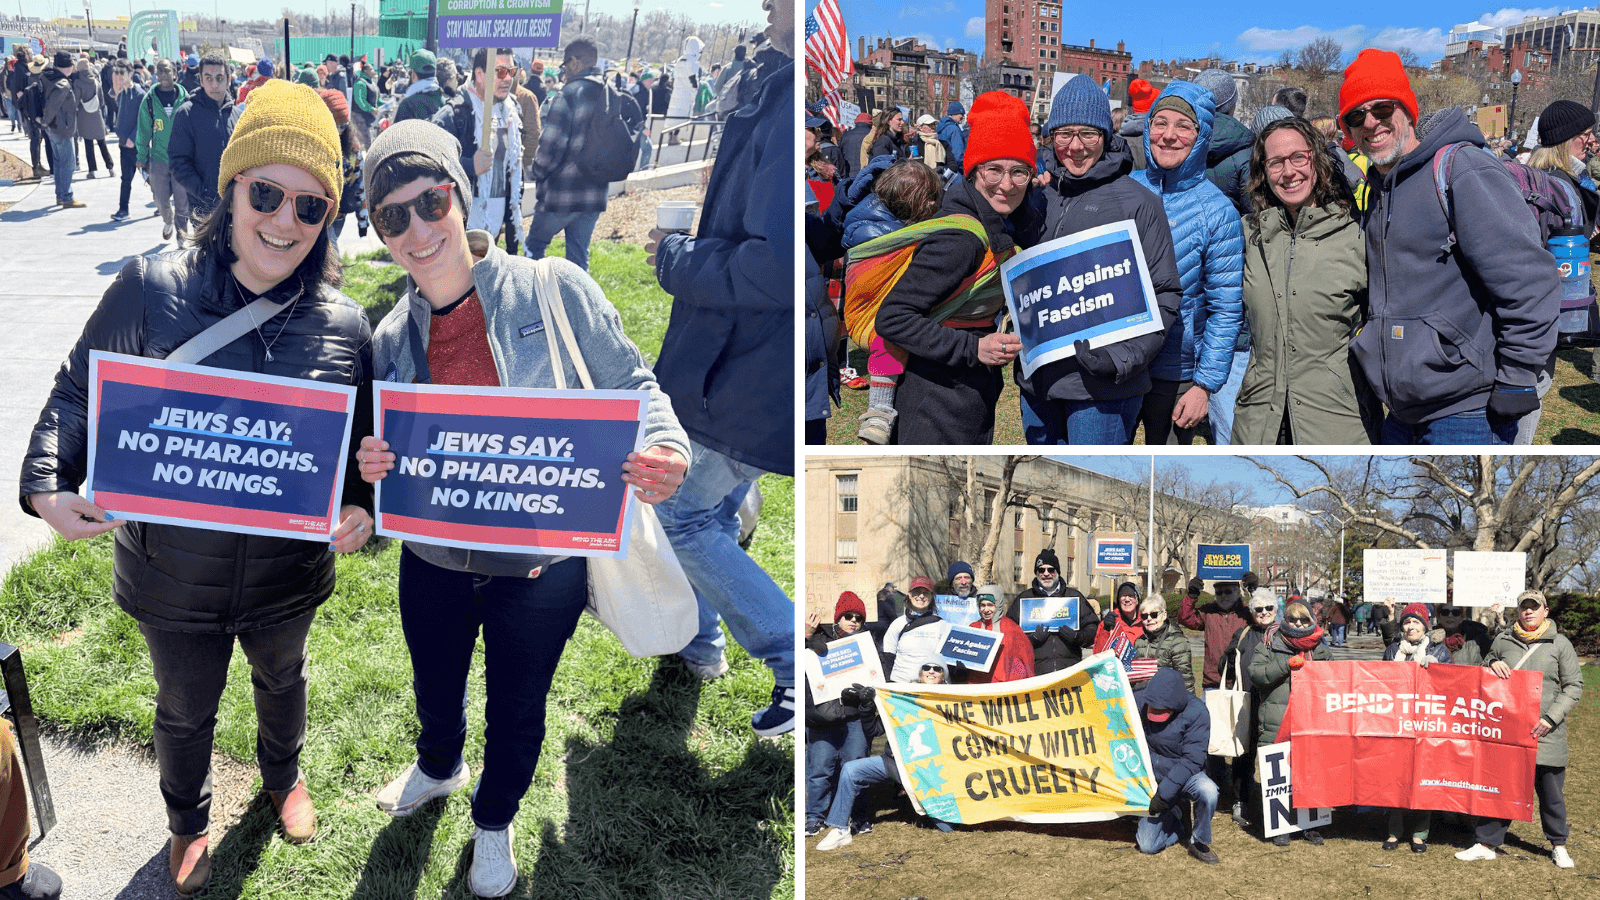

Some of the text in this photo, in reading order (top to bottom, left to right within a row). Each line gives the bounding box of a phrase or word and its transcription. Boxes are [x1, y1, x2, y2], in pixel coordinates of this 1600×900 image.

[448, 0, 550, 10] CORRUPTION & CRONYISM
[447, 18, 552, 38] STAY VIGILANT. SPEAK OUT. RESIST.
[1019, 258, 1131, 312] Jews Against
[1038, 292, 1114, 328] Fascism
[154, 406, 292, 442] JEWS SAY:
[117, 430, 319, 473] NO PHARAOHS.
[430, 432, 574, 458] JEWS SAY:
[152, 463, 282, 496] NO KINGS.
[399, 456, 605, 489] NO PHARAOHS.
[431, 487, 564, 515] NO KINGS.
[948, 637, 991, 650] Jews Against
[952, 646, 978, 656] Fascism
[936, 686, 1084, 726] WE WILL NOT
[1326, 693, 1503, 722] BEND THE ARC
[952, 725, 1097, 761] COMPLY WITH
[1398, 716, 1502, 739] jewish action
[965, 764, 1100, 801] CRUELTY
[1266, 752, 1286, 786] I
[1266, 785, 1292, 797] IMMI
[1421, 778, 1499, 793] www.bendthearc.us
